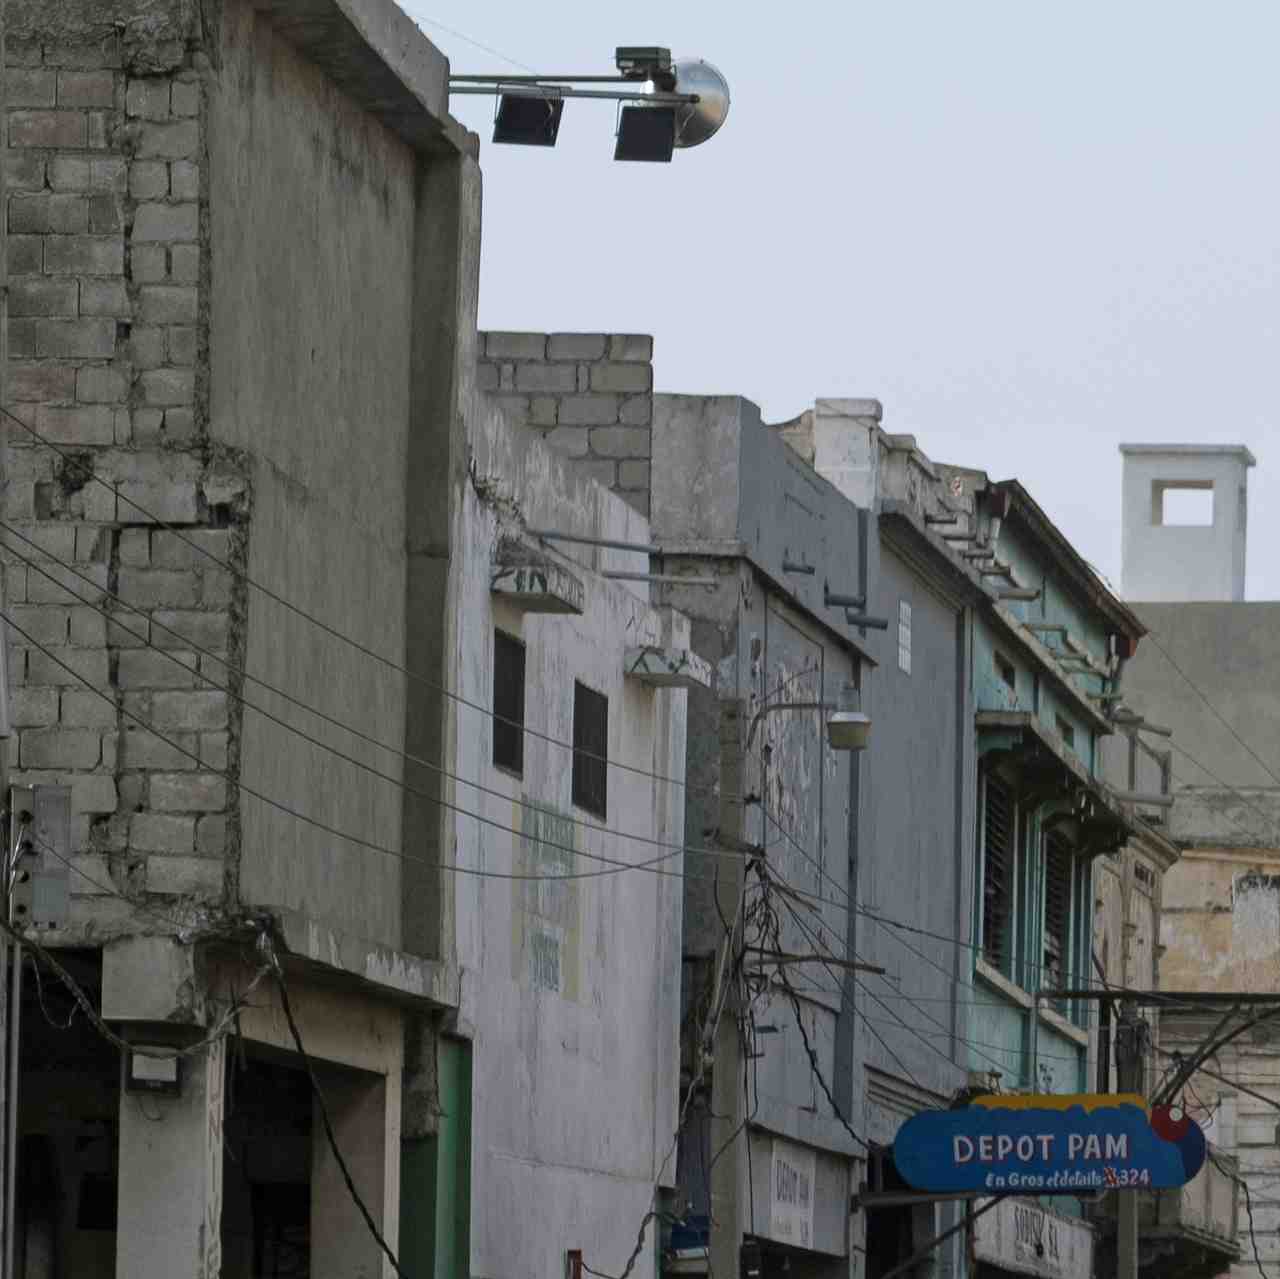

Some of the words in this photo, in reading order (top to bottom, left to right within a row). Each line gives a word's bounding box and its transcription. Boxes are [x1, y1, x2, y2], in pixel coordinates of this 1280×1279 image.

[954, 1134, 1054, 1162] DEPOT
[1068, 1133, 1128, 1160] PAM
[985, 1172, 1005, 1187] En
[1008, 1172, 1043, 1187] Gros
